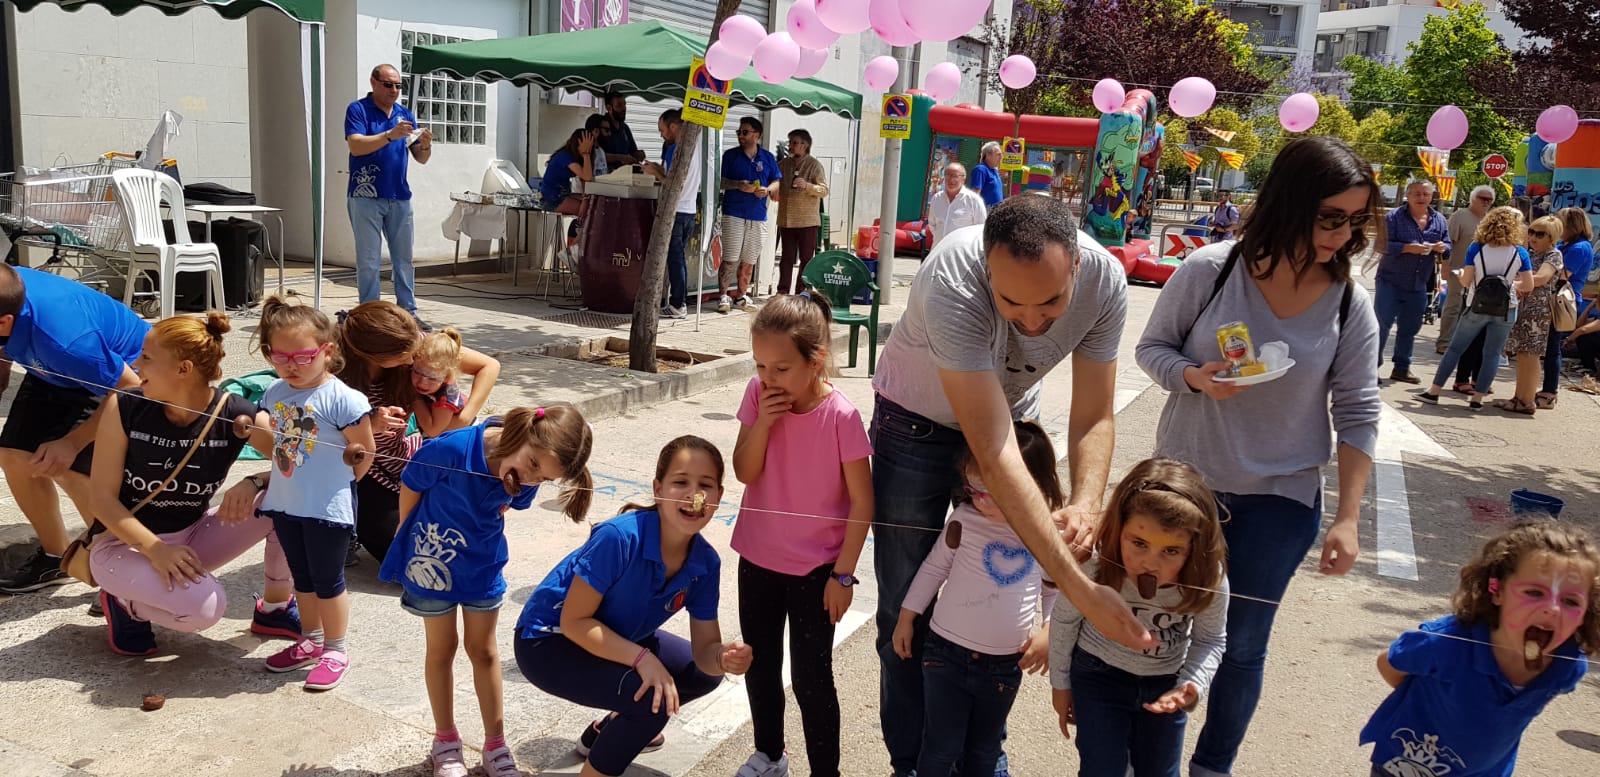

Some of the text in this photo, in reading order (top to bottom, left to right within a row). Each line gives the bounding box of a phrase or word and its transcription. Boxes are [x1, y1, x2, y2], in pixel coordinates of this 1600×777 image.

[823, 273, 852, 281] ESTRELLA
[152, 436, 176, 448] THIS
[179, 439, 206, 448] WIL
